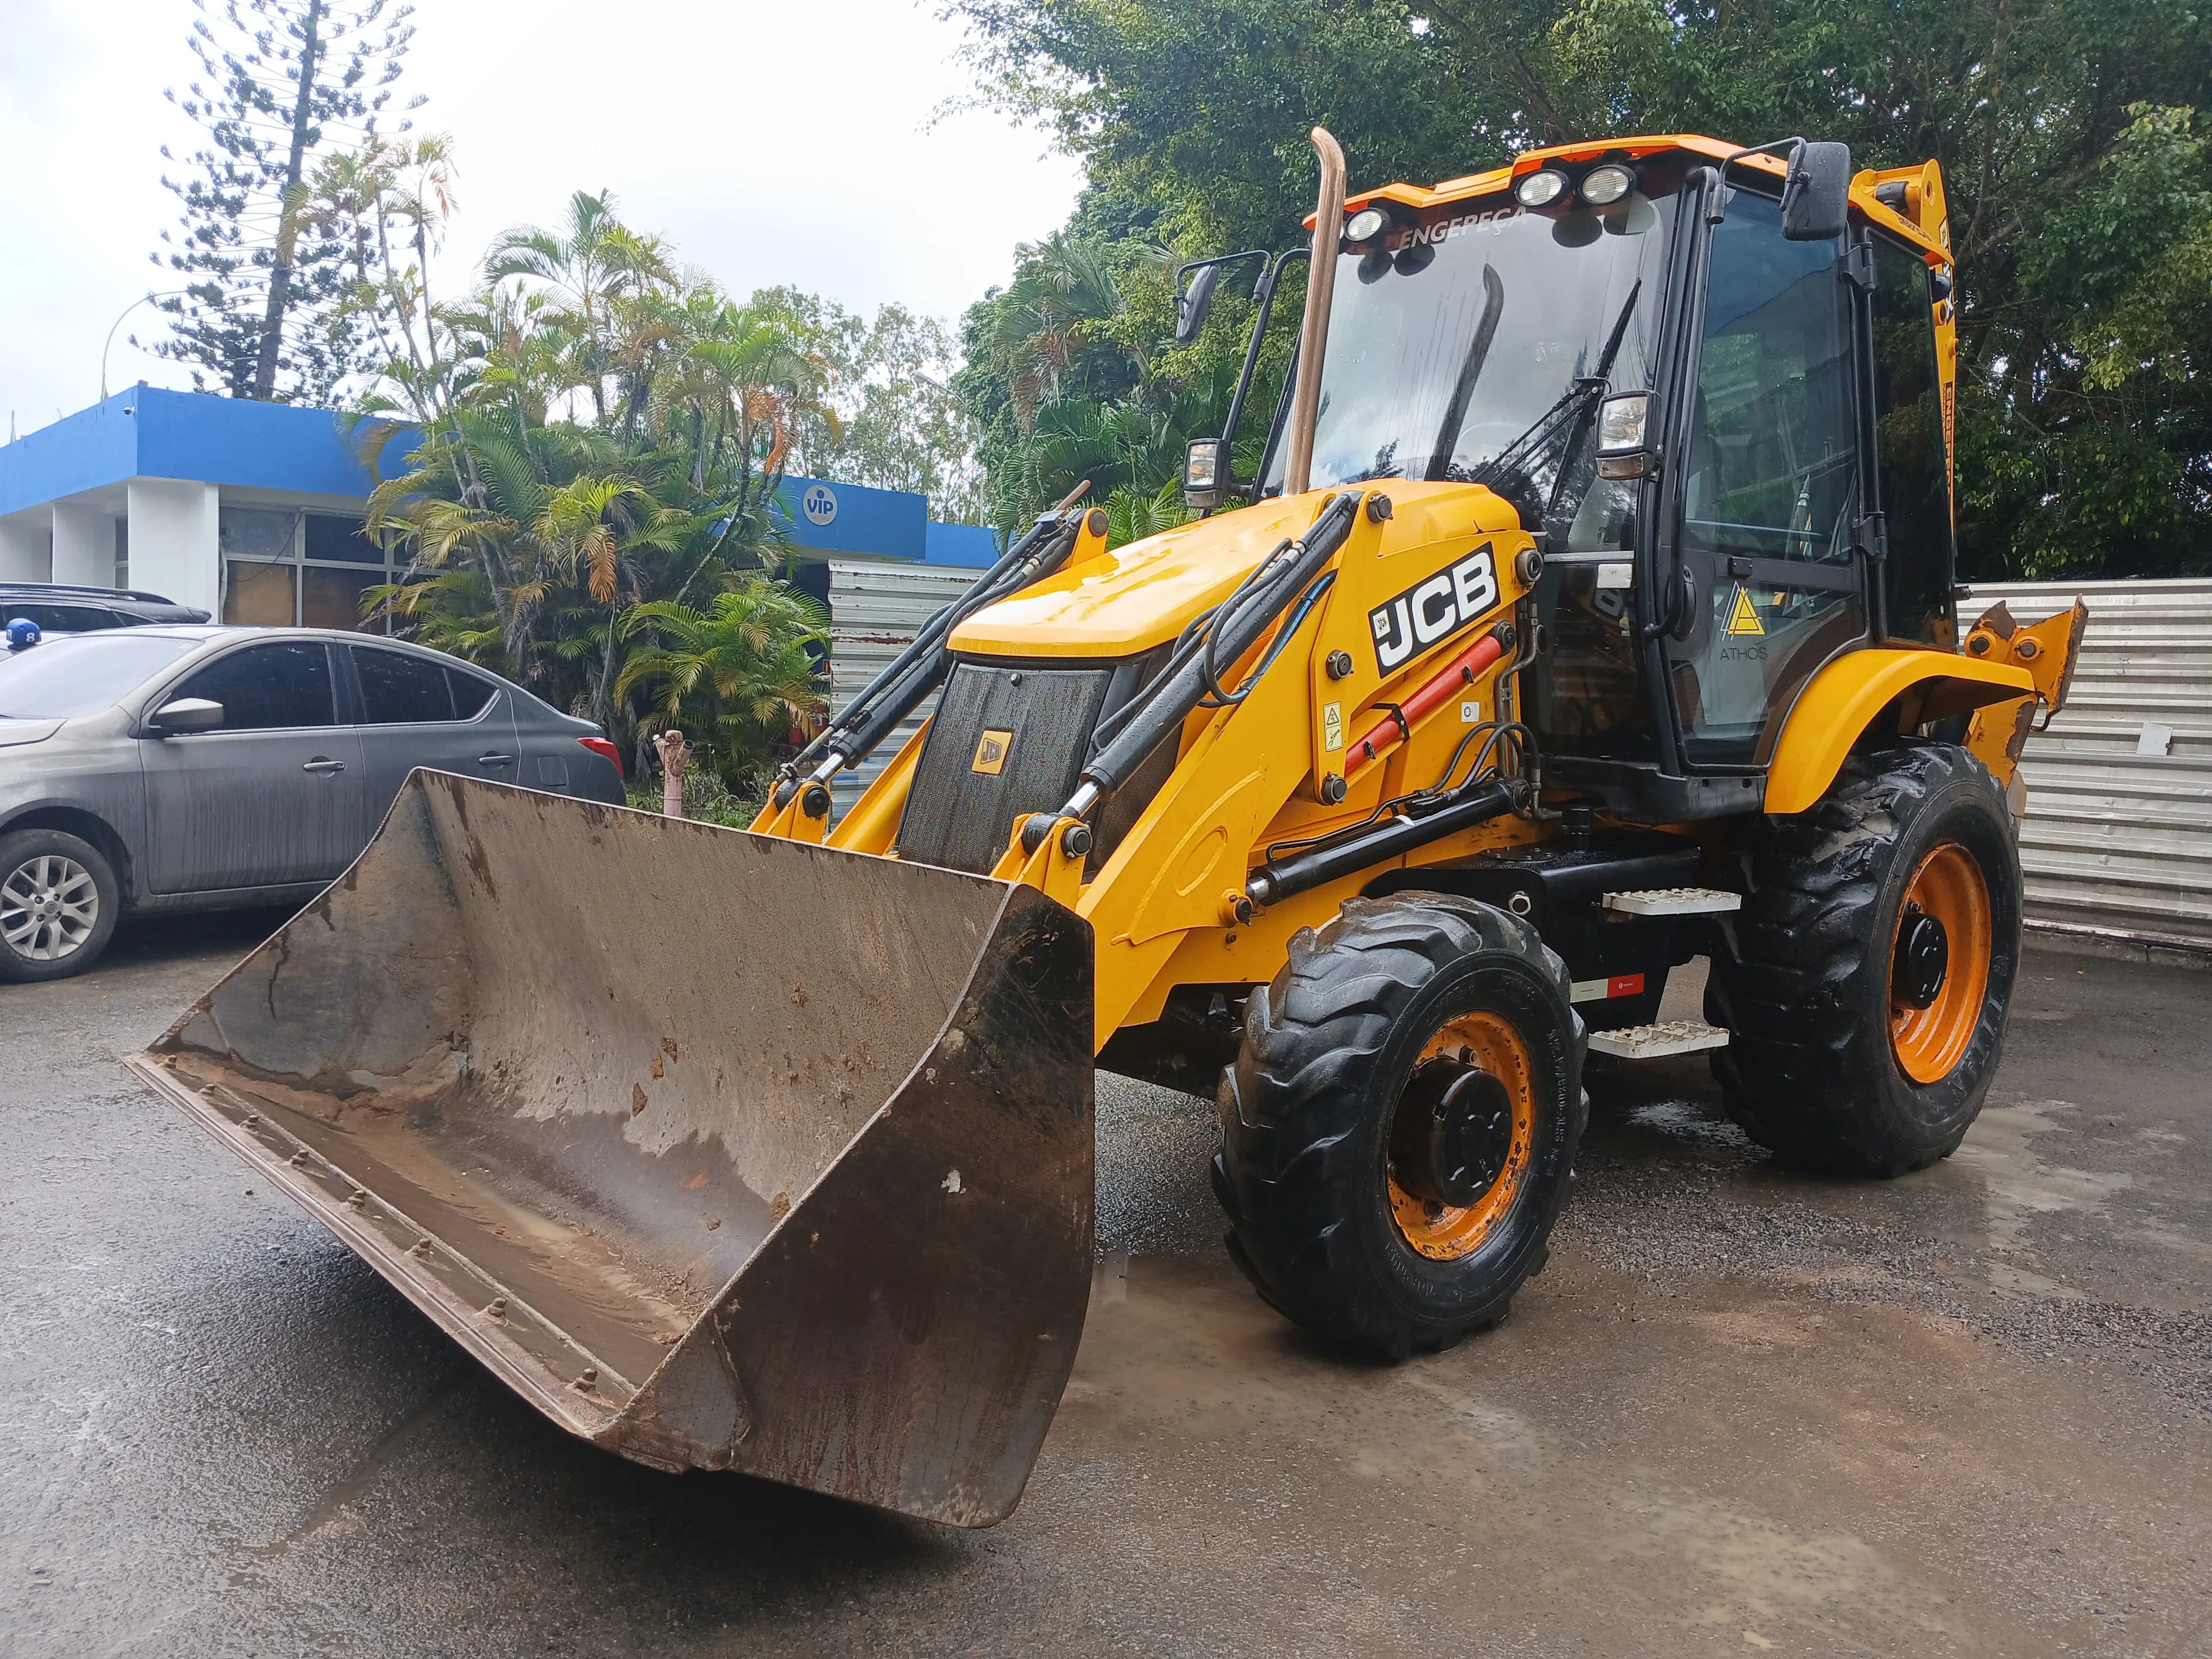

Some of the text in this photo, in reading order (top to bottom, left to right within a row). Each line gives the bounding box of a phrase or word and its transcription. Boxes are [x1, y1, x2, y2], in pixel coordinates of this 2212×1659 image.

[1398, 205, 1527, 250] ENGEPEÇA
[1378, 552, 1496, 667] JCB
[26, 633, 35, 642] 8
[1720, 647, 1768, 660] ATHOS
[982, 741, 1001, 762] JCB
